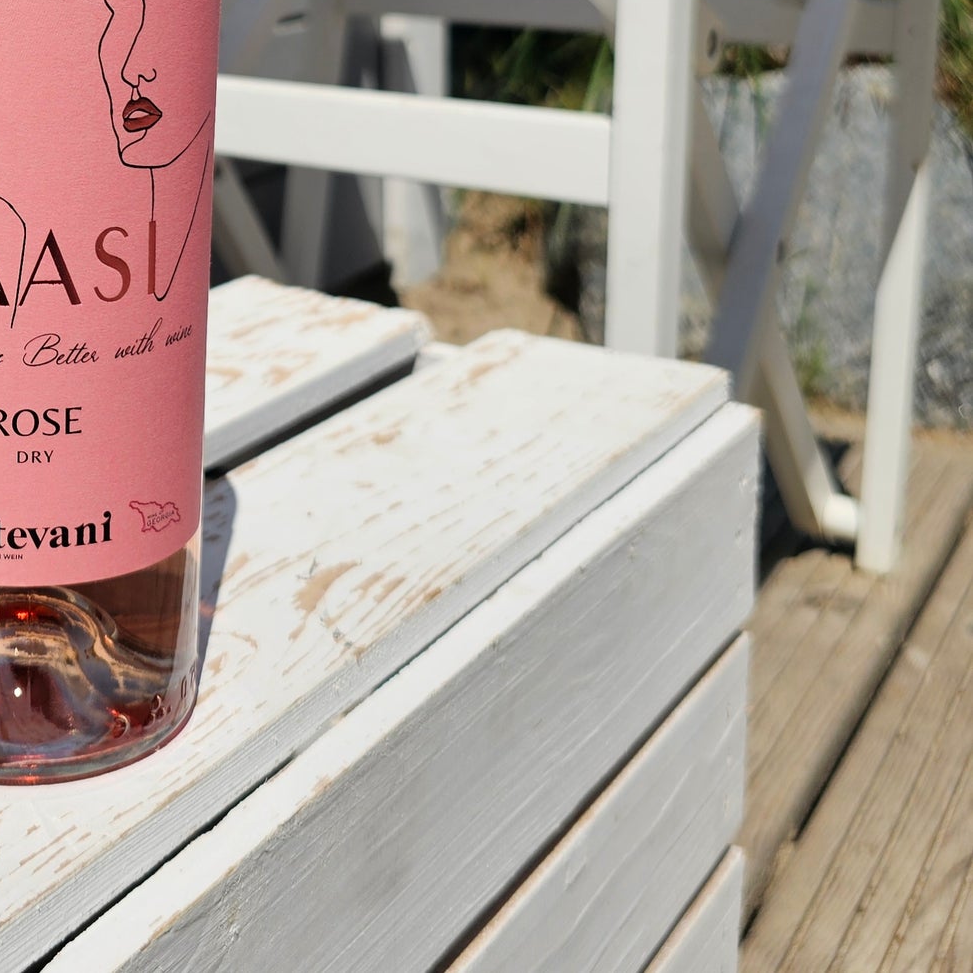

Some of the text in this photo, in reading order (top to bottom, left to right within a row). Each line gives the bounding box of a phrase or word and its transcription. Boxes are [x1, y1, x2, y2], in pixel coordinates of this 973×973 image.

[23, 333, 100, 367] Better
[114, 316, 164, 359] with
[165, 324, 192, 346] wine
[17, 450, 54, 463] DRY
